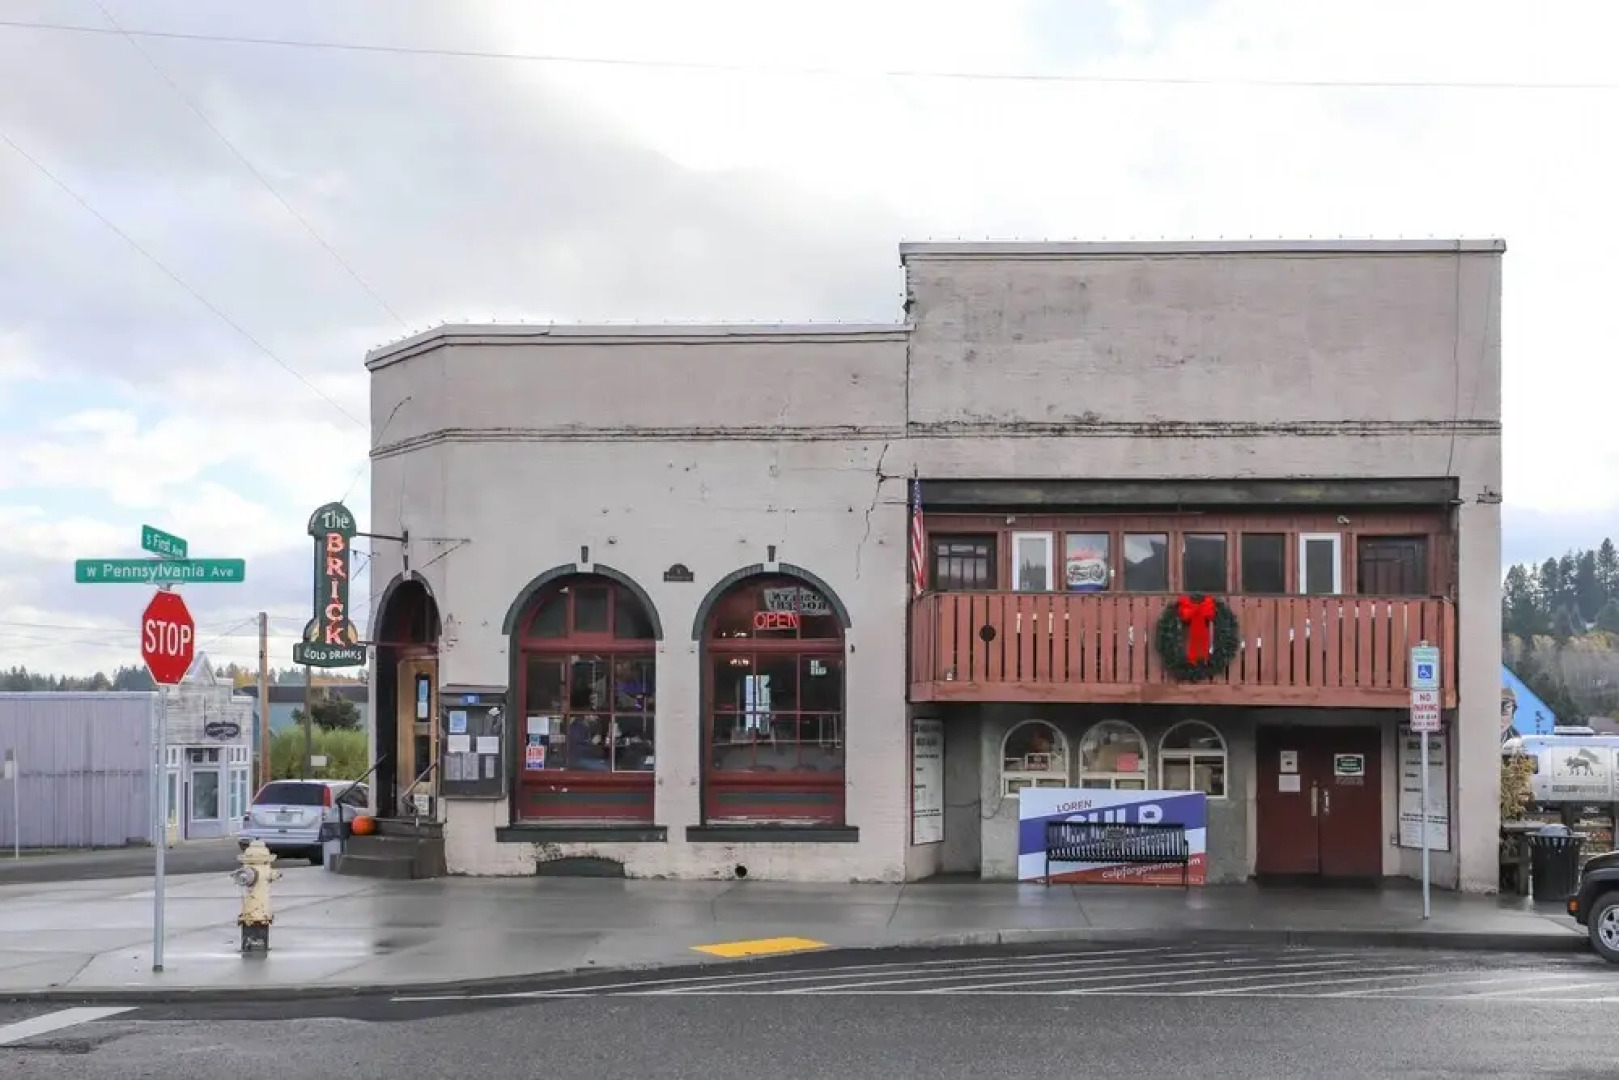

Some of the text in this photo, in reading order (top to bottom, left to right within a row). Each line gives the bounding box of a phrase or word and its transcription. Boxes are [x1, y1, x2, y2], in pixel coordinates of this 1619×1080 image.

[321, 509, 350, 529] The
[86, 563, 234, 581] W Pennsylvania Ave
[324, 532, 346, 646] BRICK
[753, 611, 798, 629] OPEN
[144, 618, 192, 657] STOP
[303, 648, 362, 661] COLD DRINKS
[1419, 693, 1432, 702] NO
[1055, 799, 1092, 813] LOREN
